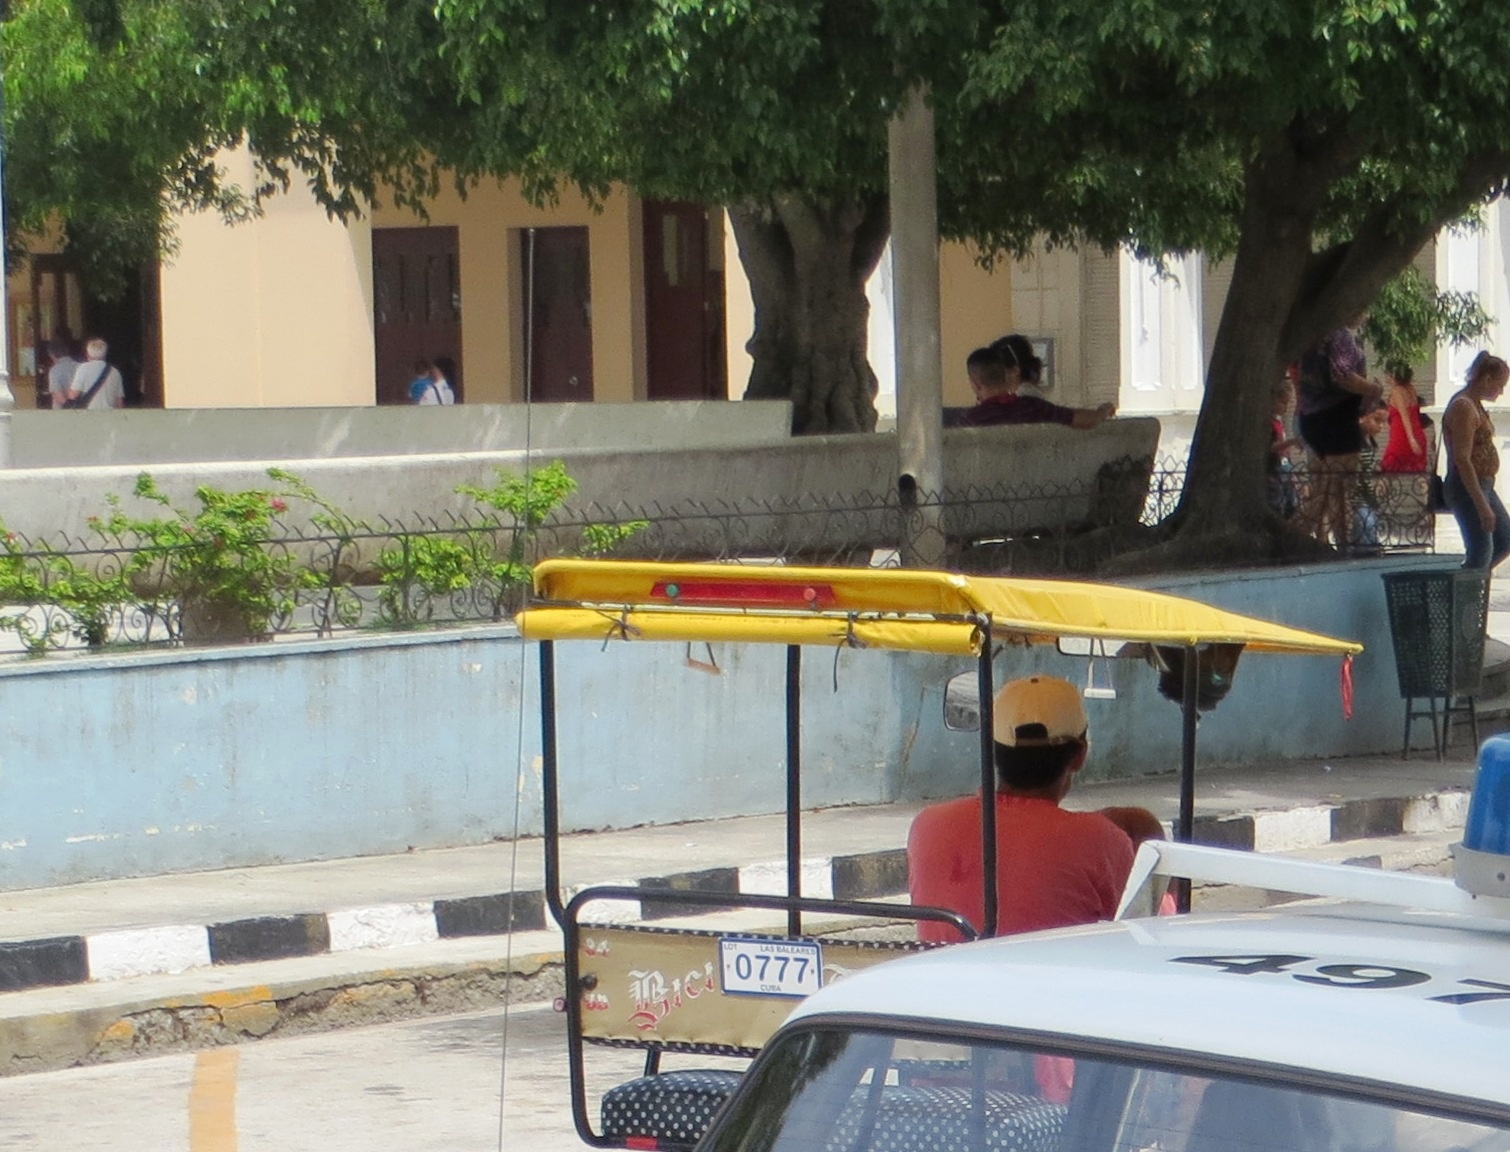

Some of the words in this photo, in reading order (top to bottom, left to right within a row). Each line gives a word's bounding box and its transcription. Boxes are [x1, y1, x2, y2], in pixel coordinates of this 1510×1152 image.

[760, 945, 775, 953] LAS
[735, 953, 810, 984] 0777
[759, 984, 782, 992] CUBA
